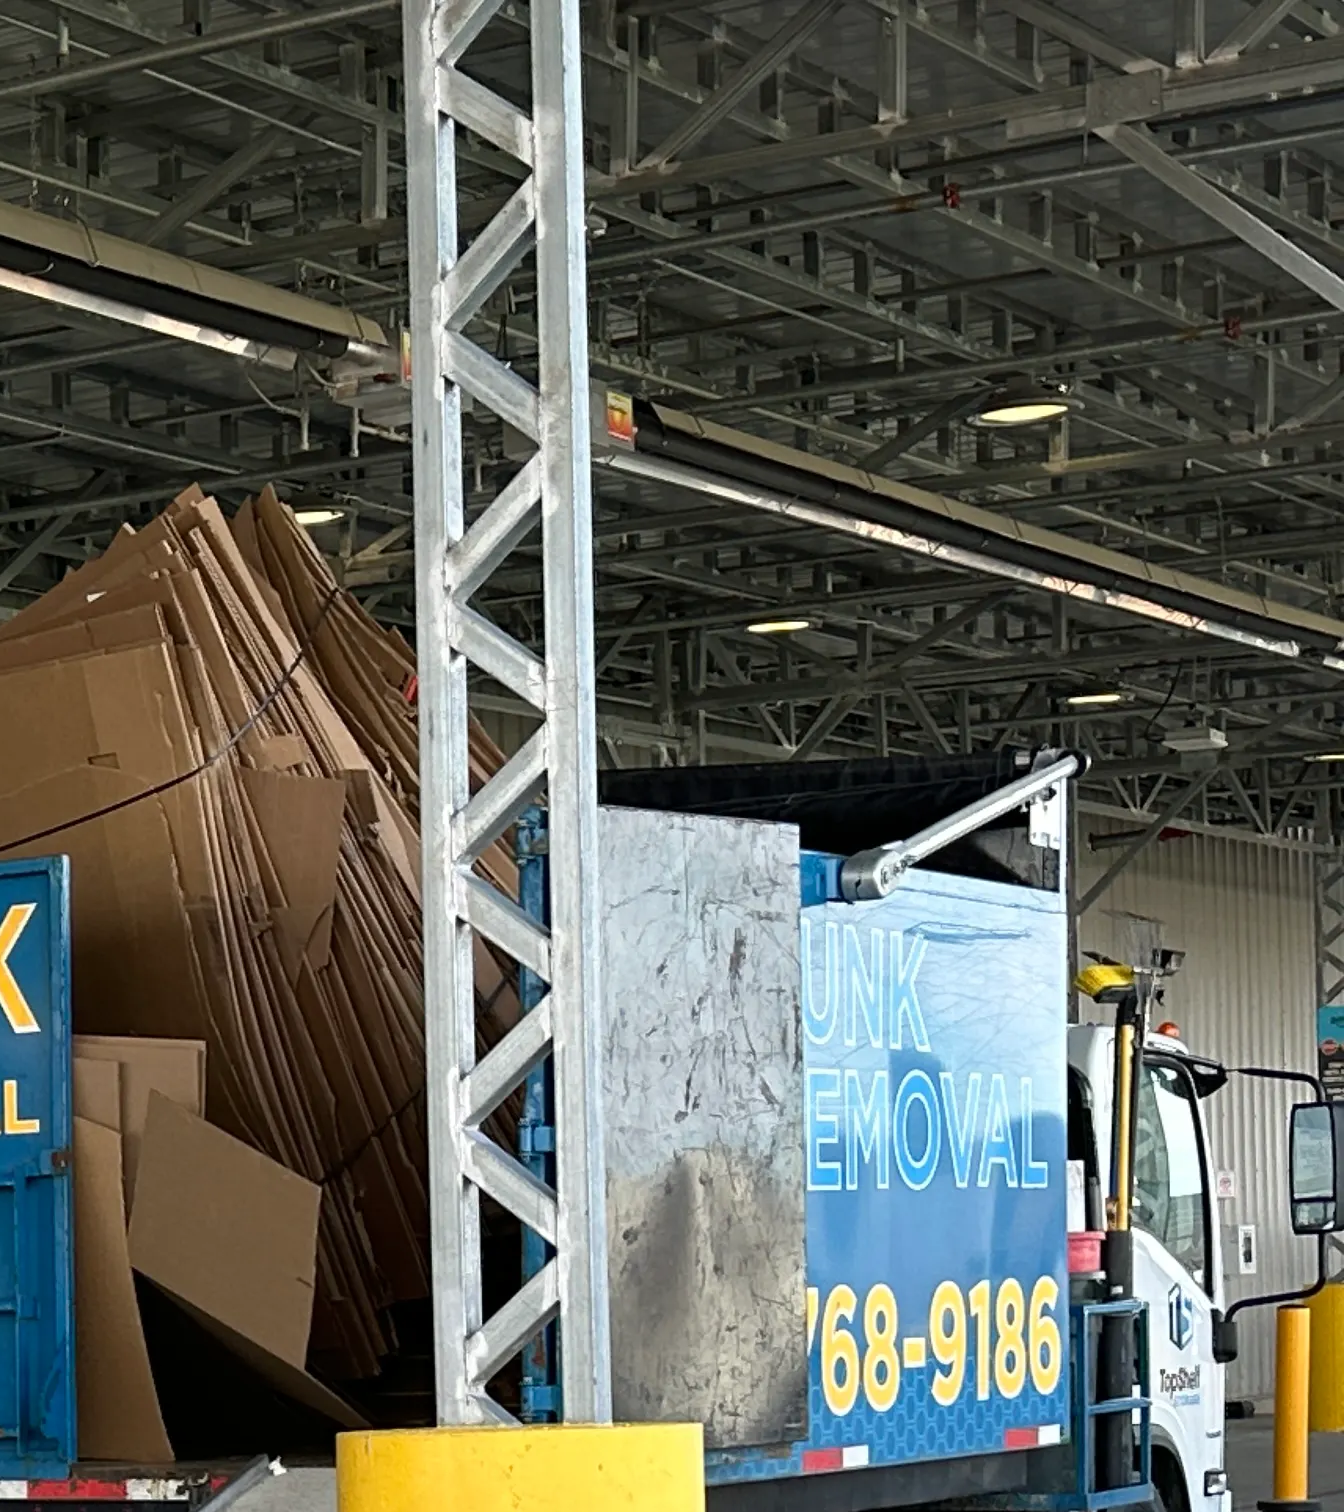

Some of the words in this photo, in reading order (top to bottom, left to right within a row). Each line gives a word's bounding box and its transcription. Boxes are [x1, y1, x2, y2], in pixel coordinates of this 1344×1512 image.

[801, 917, 931, 1052] UNK
[806, 1067, 1048, 1191] EMOVAL
[1160, 1364, 1200, 1399] TopShelf
